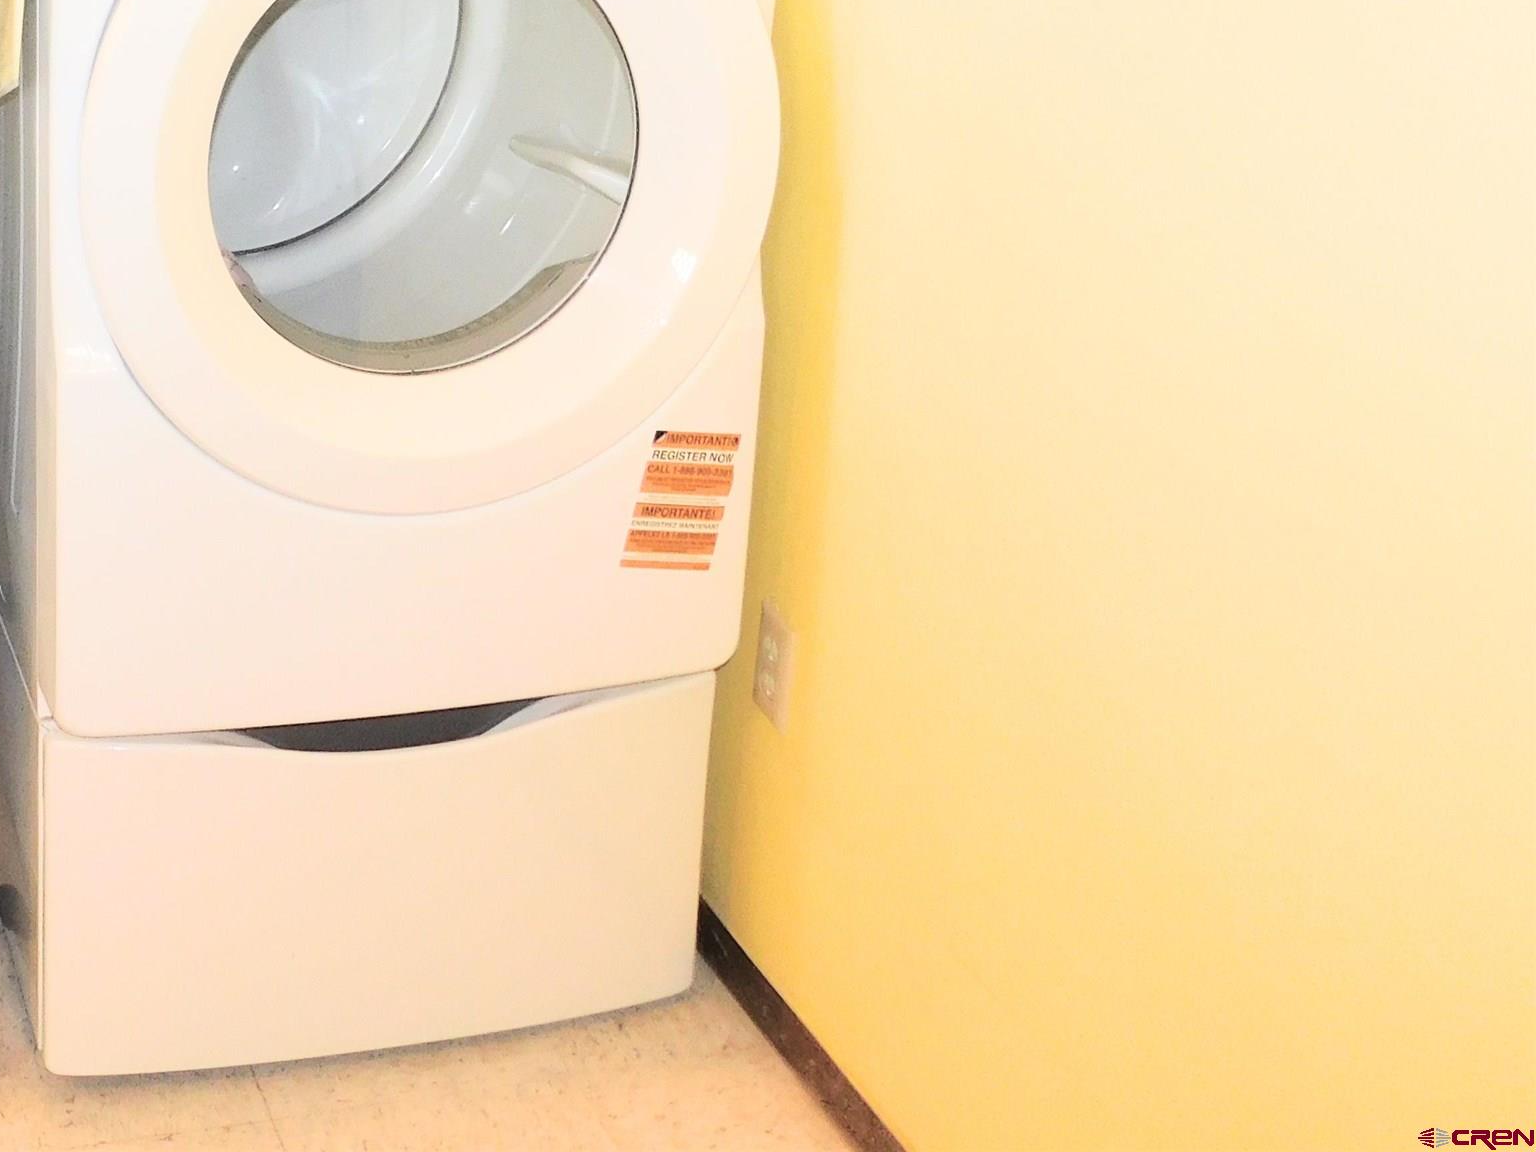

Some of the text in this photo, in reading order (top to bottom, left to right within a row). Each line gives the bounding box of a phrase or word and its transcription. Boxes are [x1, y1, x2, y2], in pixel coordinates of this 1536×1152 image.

[652, 450, 734, 463] REGISTER NOW
[647, 464, 671, 474] CALL
